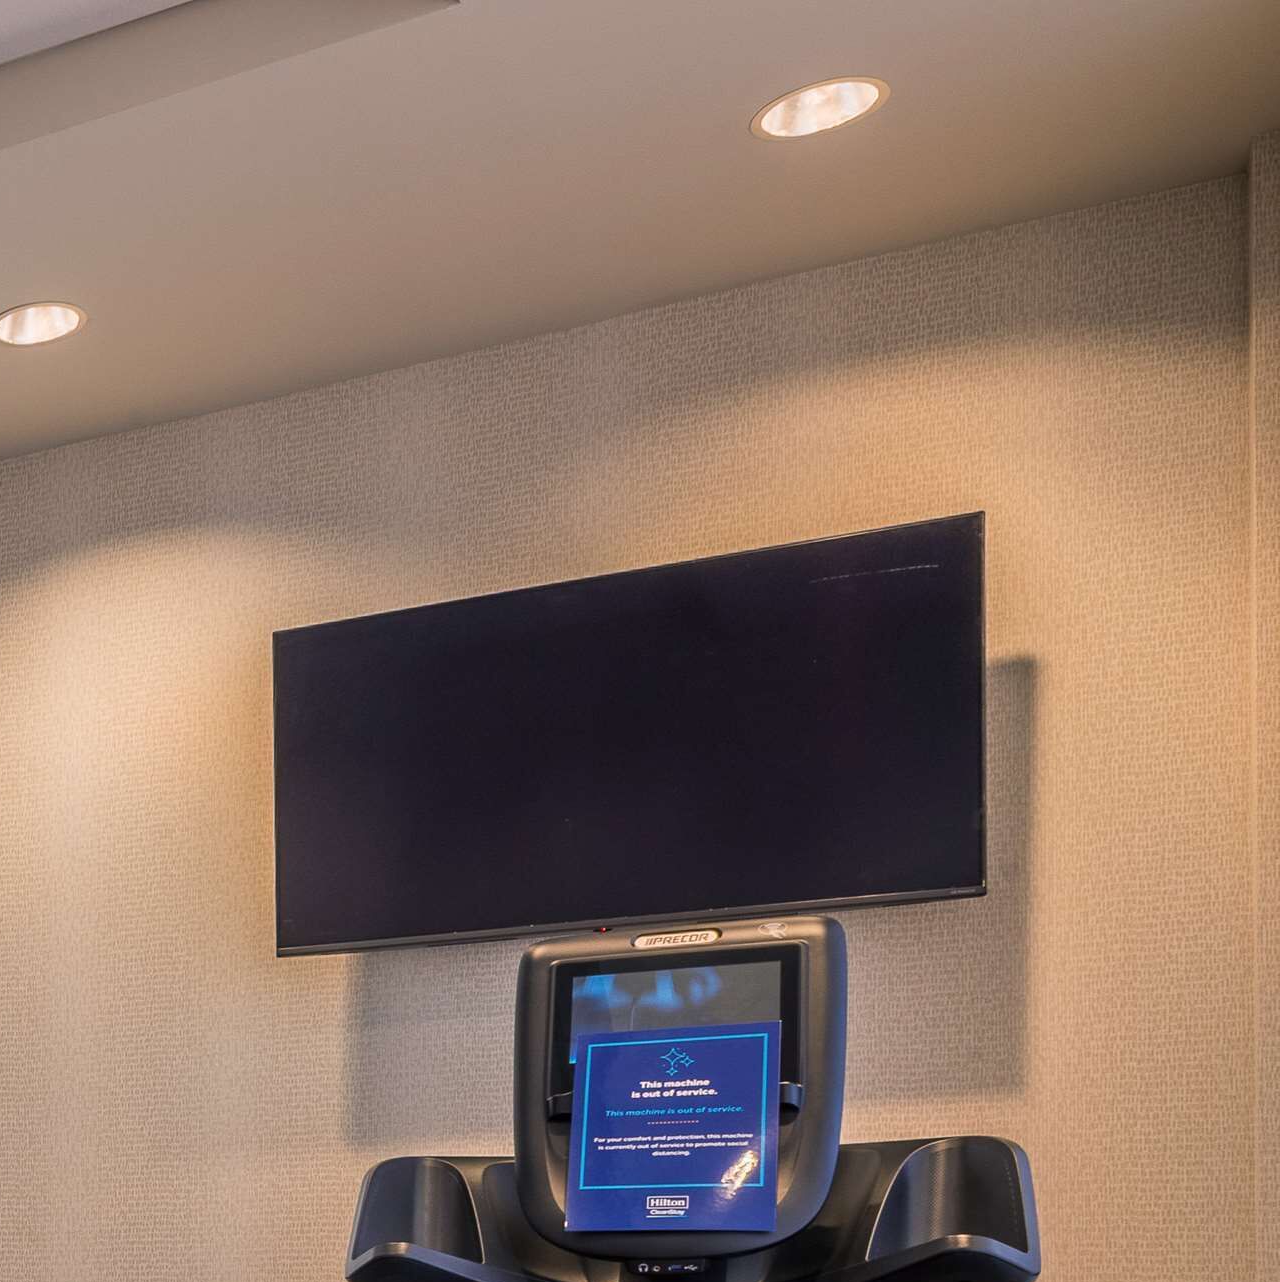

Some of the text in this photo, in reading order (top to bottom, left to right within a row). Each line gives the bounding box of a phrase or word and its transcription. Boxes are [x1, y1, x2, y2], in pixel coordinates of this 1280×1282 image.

[652, 932, 710, 945] PRECOR
[640, 1079, 710, 1089] This machine
[631, 1087, 718, 1099] is out of service.
[605, 1105, 744, 1118] This machine is out of service.
[650, 1199, 685, 1207] Hilton
